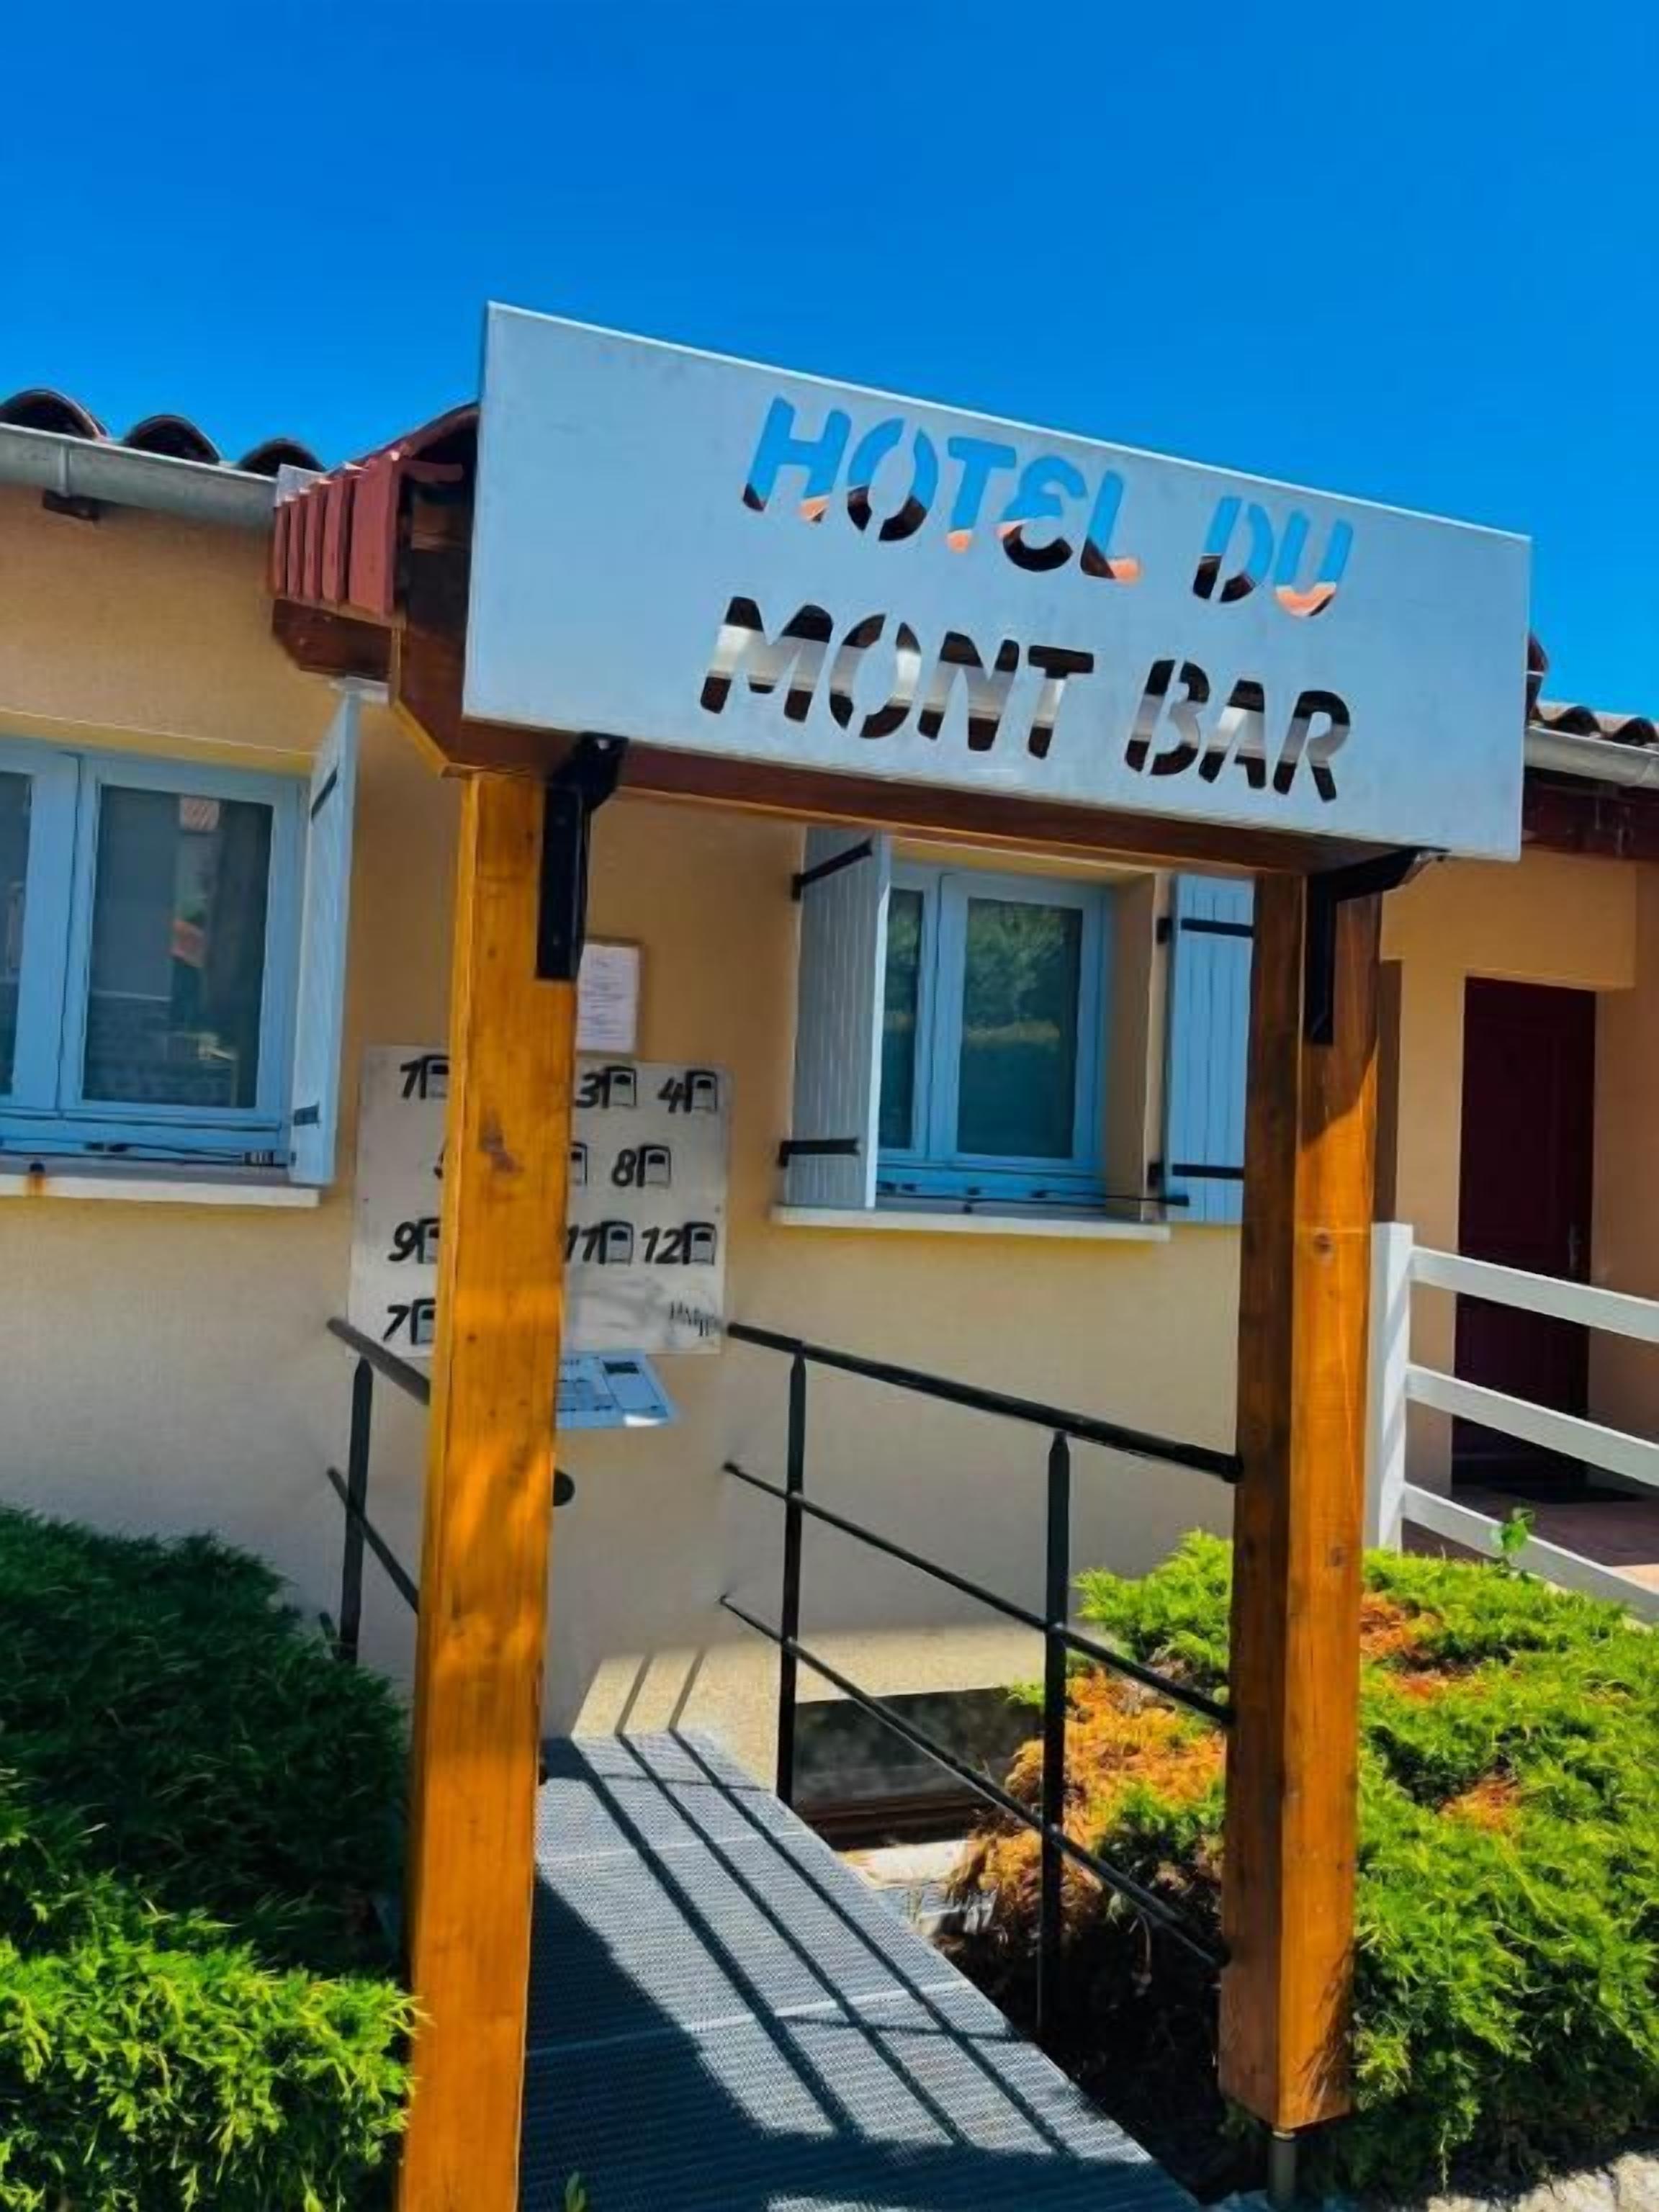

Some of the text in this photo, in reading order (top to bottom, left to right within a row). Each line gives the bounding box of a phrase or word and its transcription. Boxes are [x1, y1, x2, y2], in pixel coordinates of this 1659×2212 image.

[742, 395, 1354, 617] HOTEL DU
[700, 596, 1351, 802] MONT BAR
[576, 1071, 601, 1108] 3
[658, 1078, 685, 1113] 4
[612, 1149, 637, 1187] 8
[388, 1221, 417, 1261] 9
[642, 1226, 683, 1264] 12
